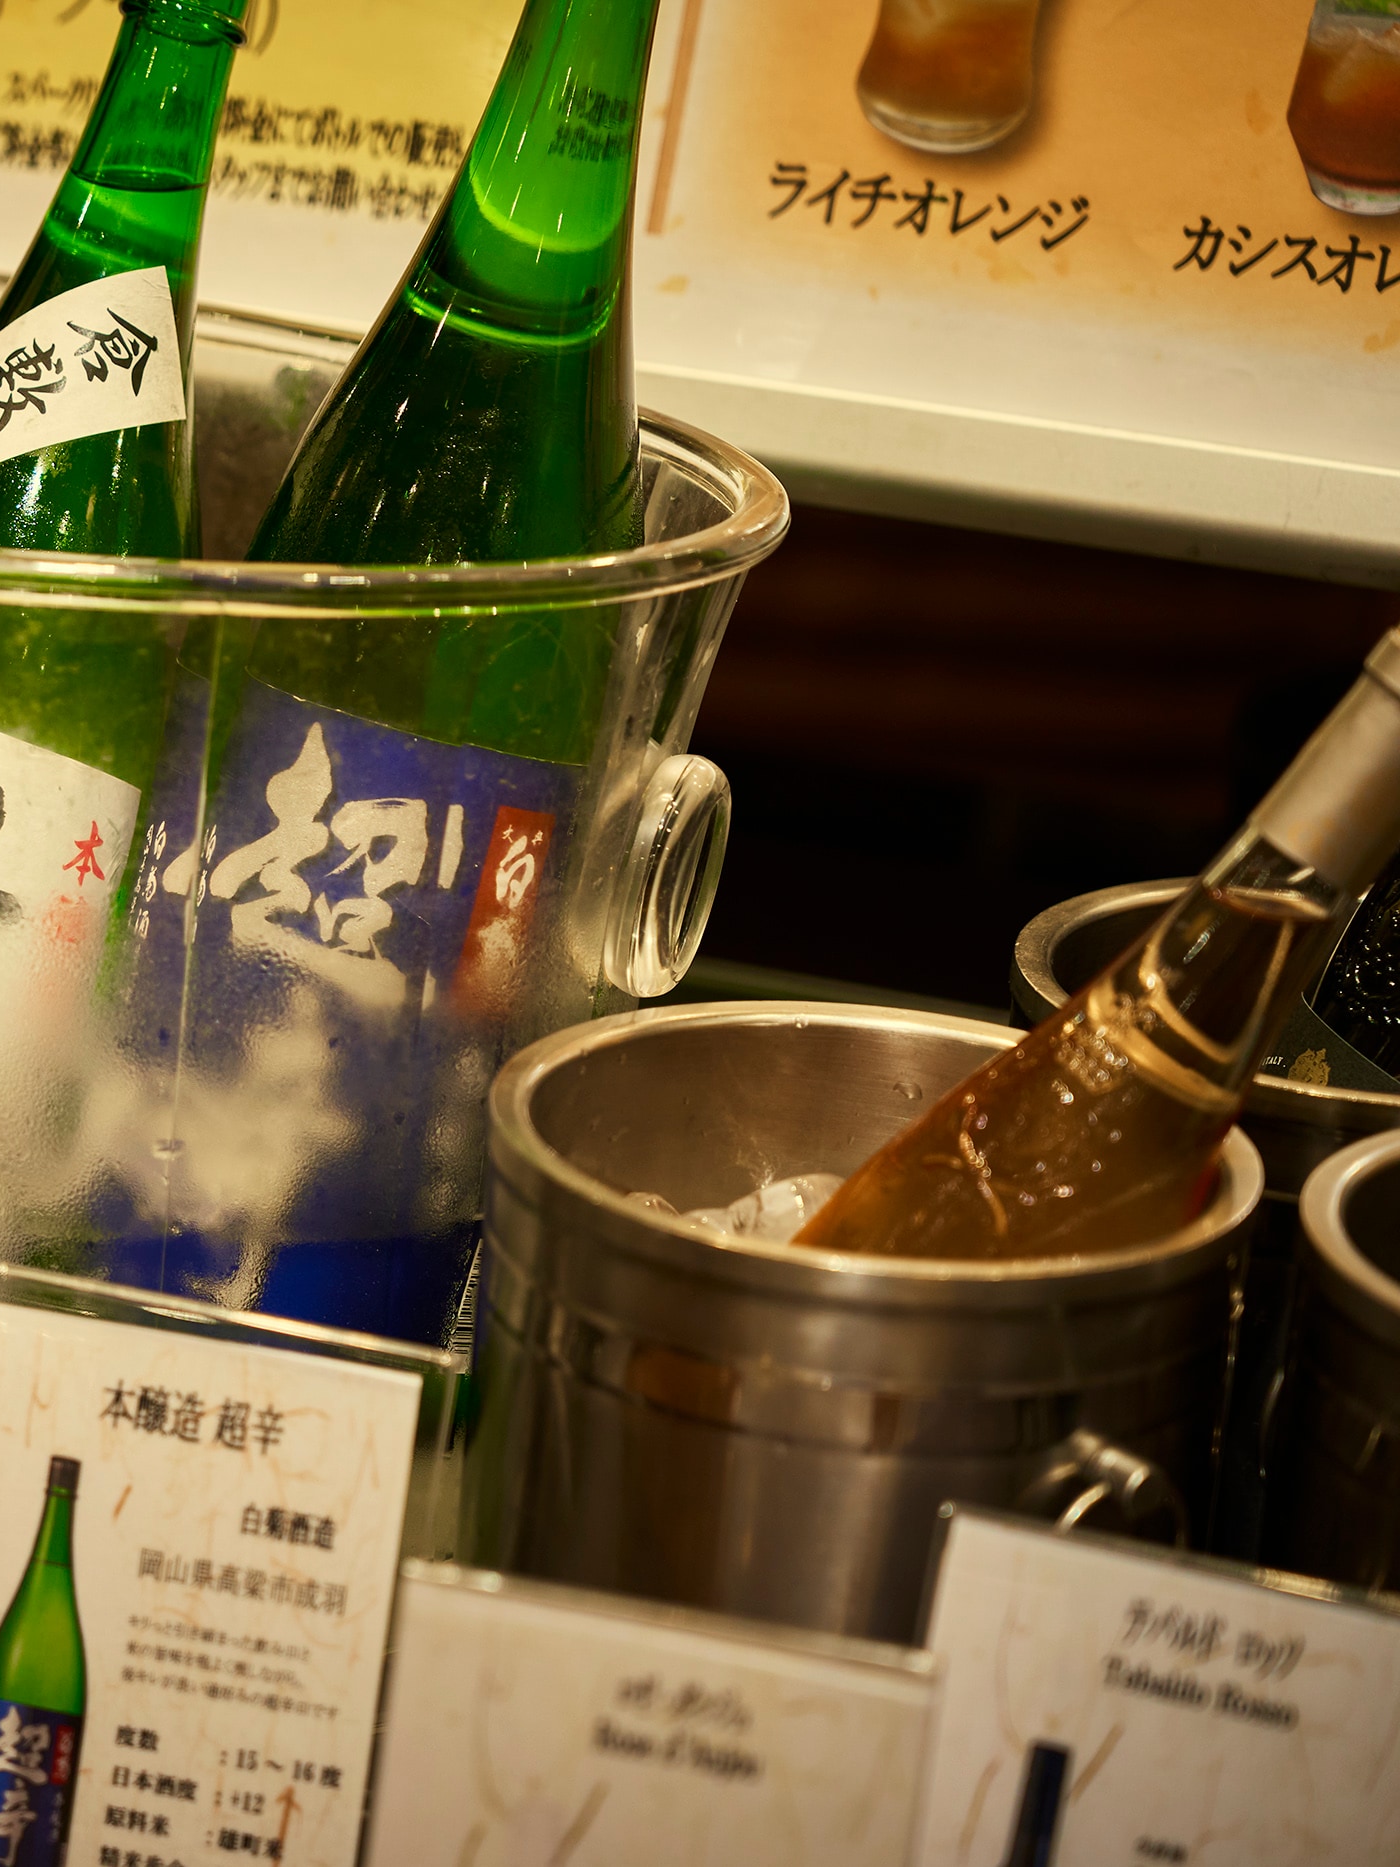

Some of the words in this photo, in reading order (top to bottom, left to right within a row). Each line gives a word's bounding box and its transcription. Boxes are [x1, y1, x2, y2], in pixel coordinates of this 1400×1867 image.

[767, 160, 1090, 253] ライチオレンジ
[114, 1724, 159, 1753] 度数
[110, 1765, 198, 1803] 日本酒度
